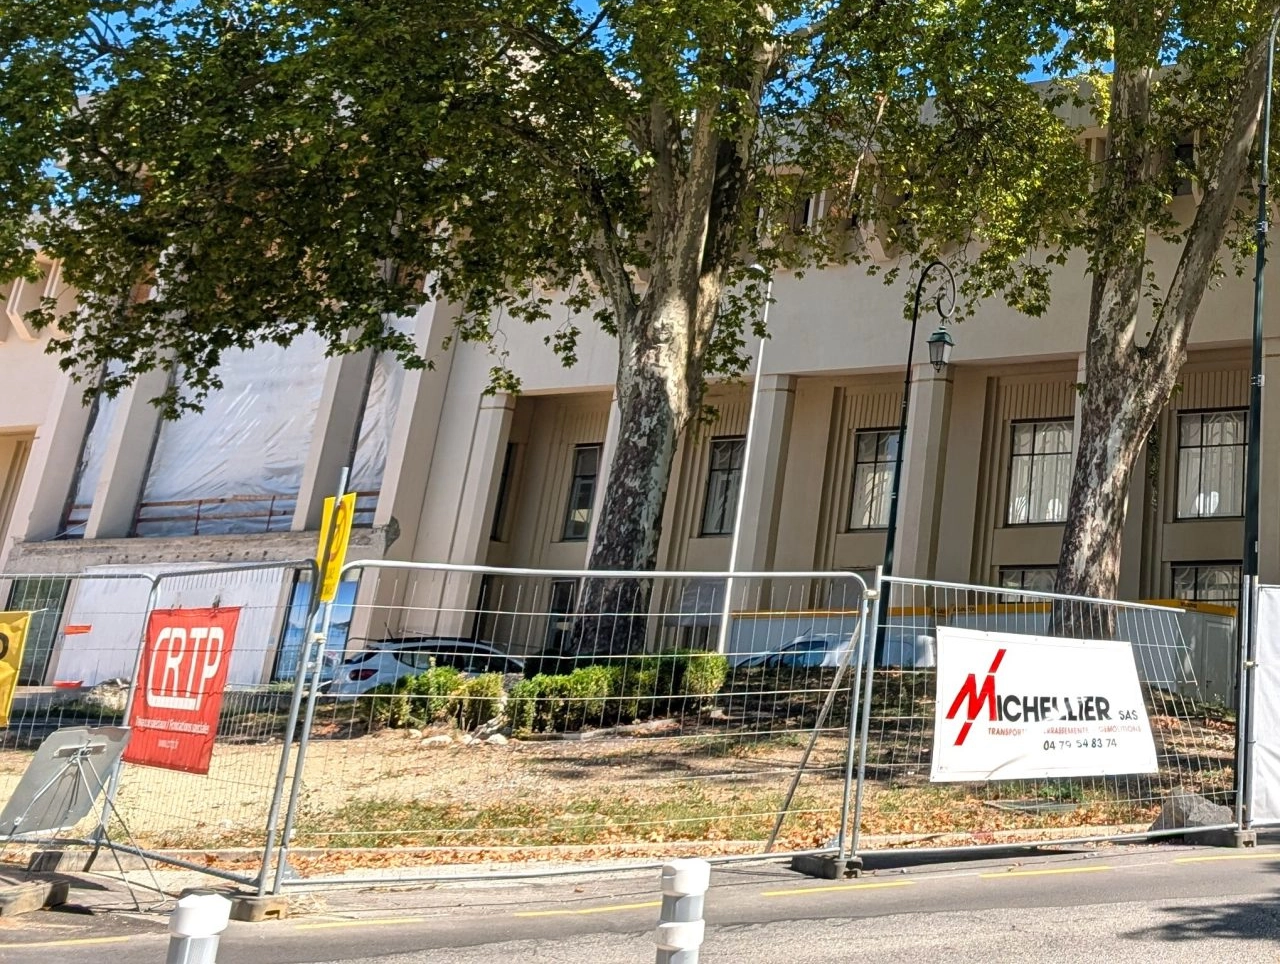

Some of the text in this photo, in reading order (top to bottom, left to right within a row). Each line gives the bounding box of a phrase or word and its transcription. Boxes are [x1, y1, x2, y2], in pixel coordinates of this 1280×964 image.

[147, 626, 225, 711] CRTP
[1118, 709, 1139, 720] SAS
[988, 727, 1028, 736] TRANSPORT
[1043, 740, 1056, 751] 04
[1091, 738, 1103, 749] 83
[1105, 738, 1117, 748] 74
